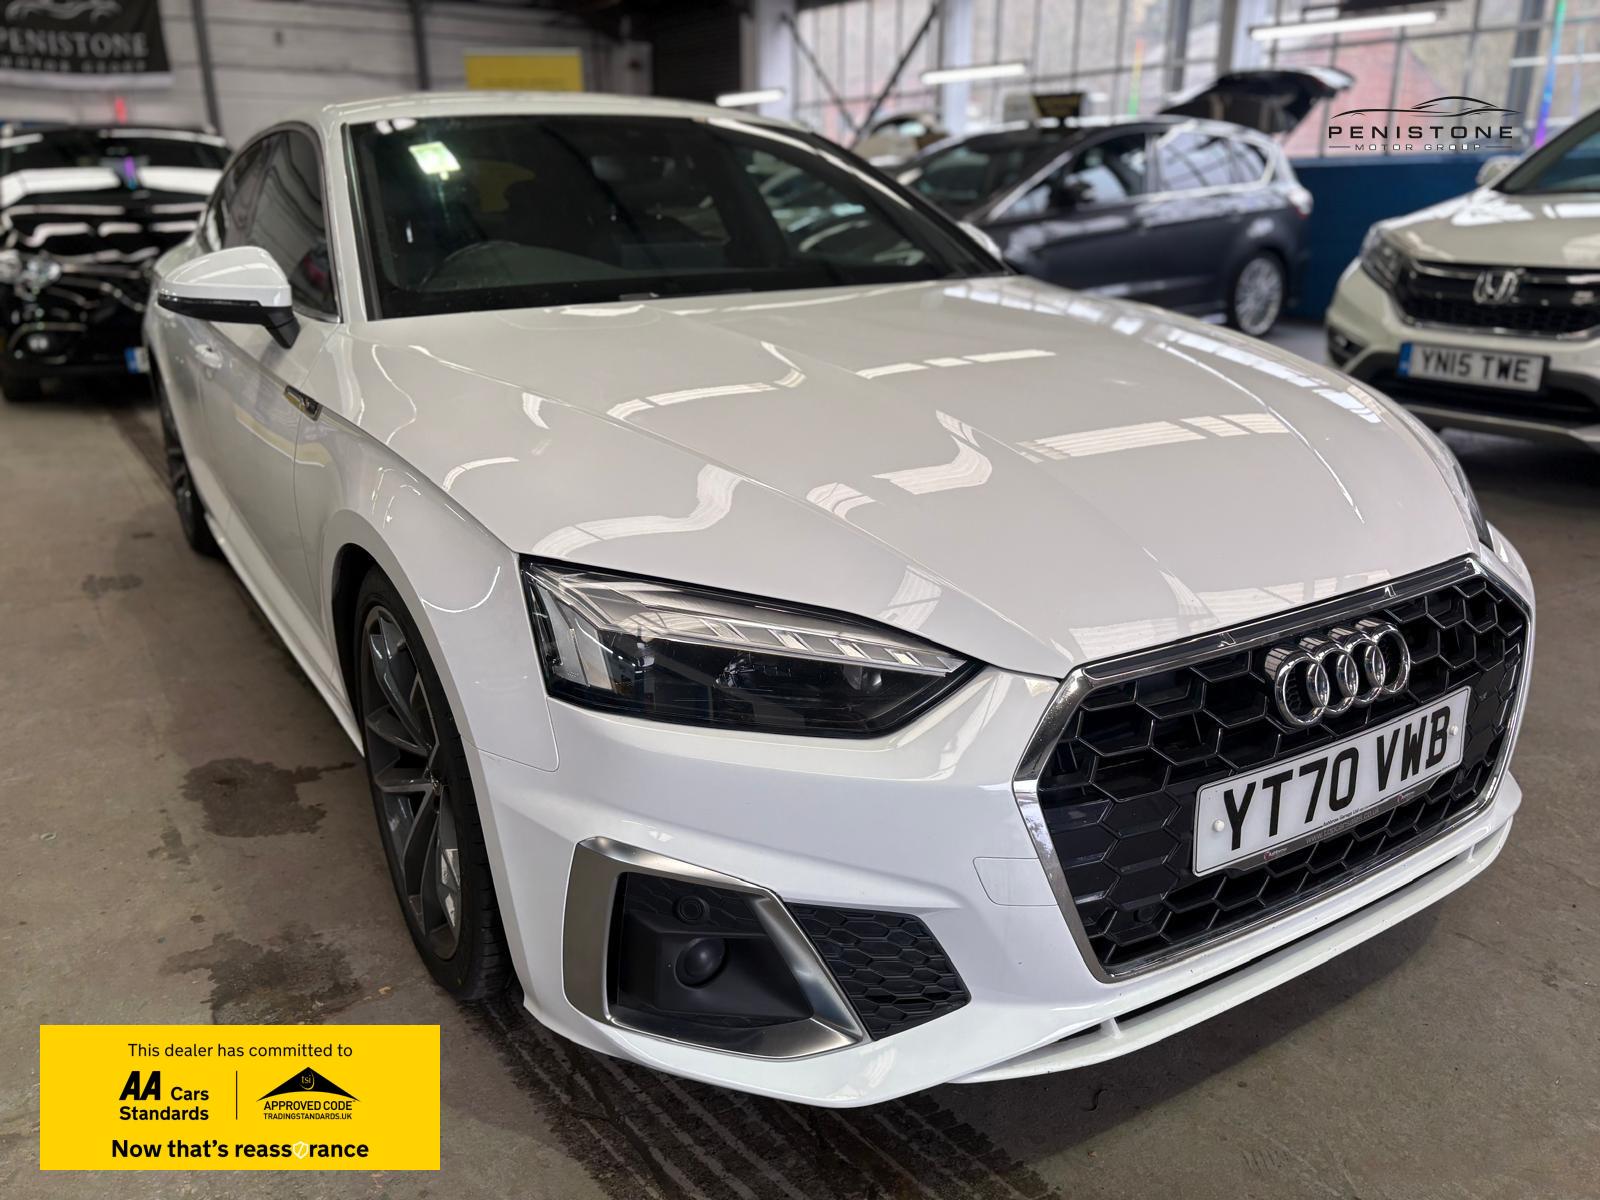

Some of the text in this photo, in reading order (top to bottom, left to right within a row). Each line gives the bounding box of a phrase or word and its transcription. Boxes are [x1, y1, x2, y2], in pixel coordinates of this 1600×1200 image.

[1421, 349, 1531, 383] YN15 TWE
[1223, 705, 1451, 851] YT70 VWB
